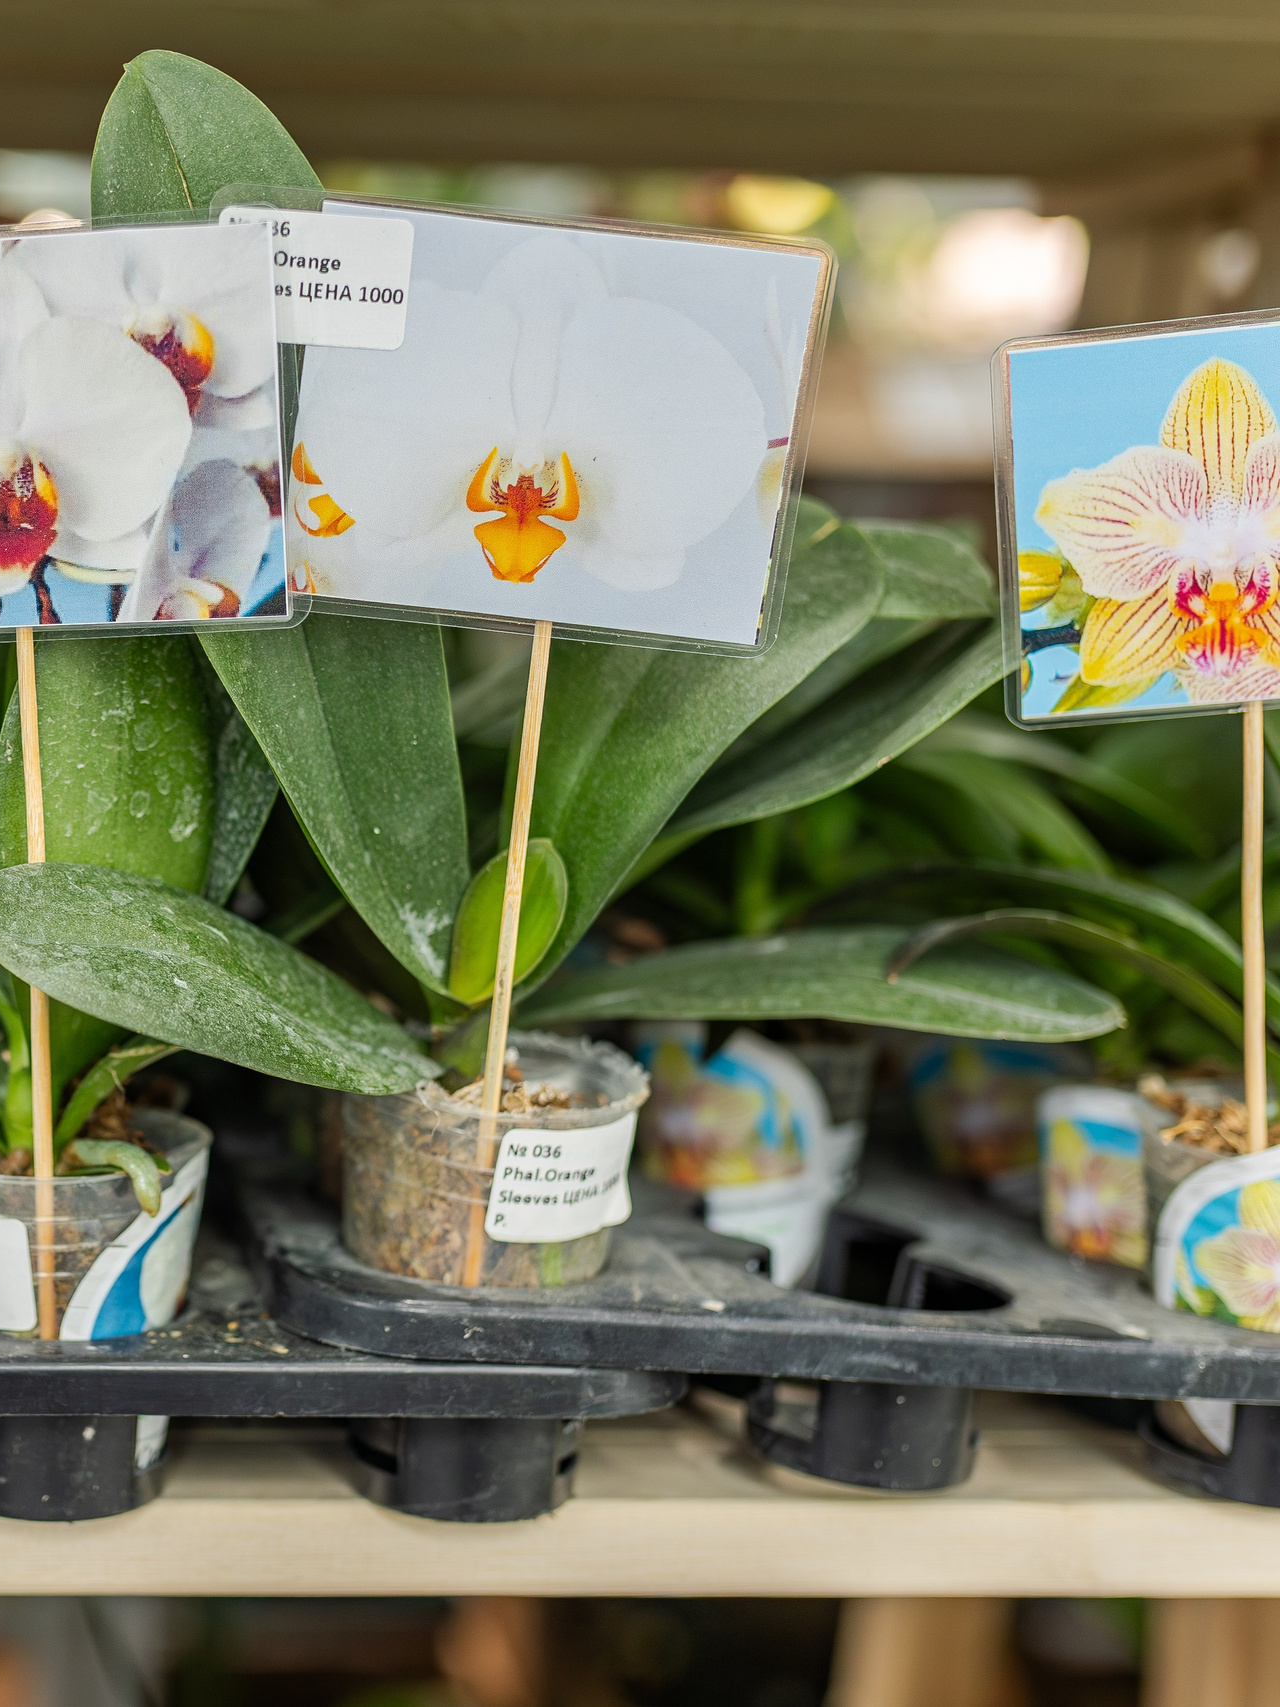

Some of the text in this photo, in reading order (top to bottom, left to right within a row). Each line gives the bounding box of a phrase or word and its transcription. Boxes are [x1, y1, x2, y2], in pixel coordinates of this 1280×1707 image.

[271, 221, 291, 237] 36
[273, 250, 341, 274] Orange
[299, 282, 352, 303] ЦЕНА
[358, 286, 405, 305] 1000
[507, 1144, 563, 1159] № 036
[498, 1189, 558, 1205] Sleeves
